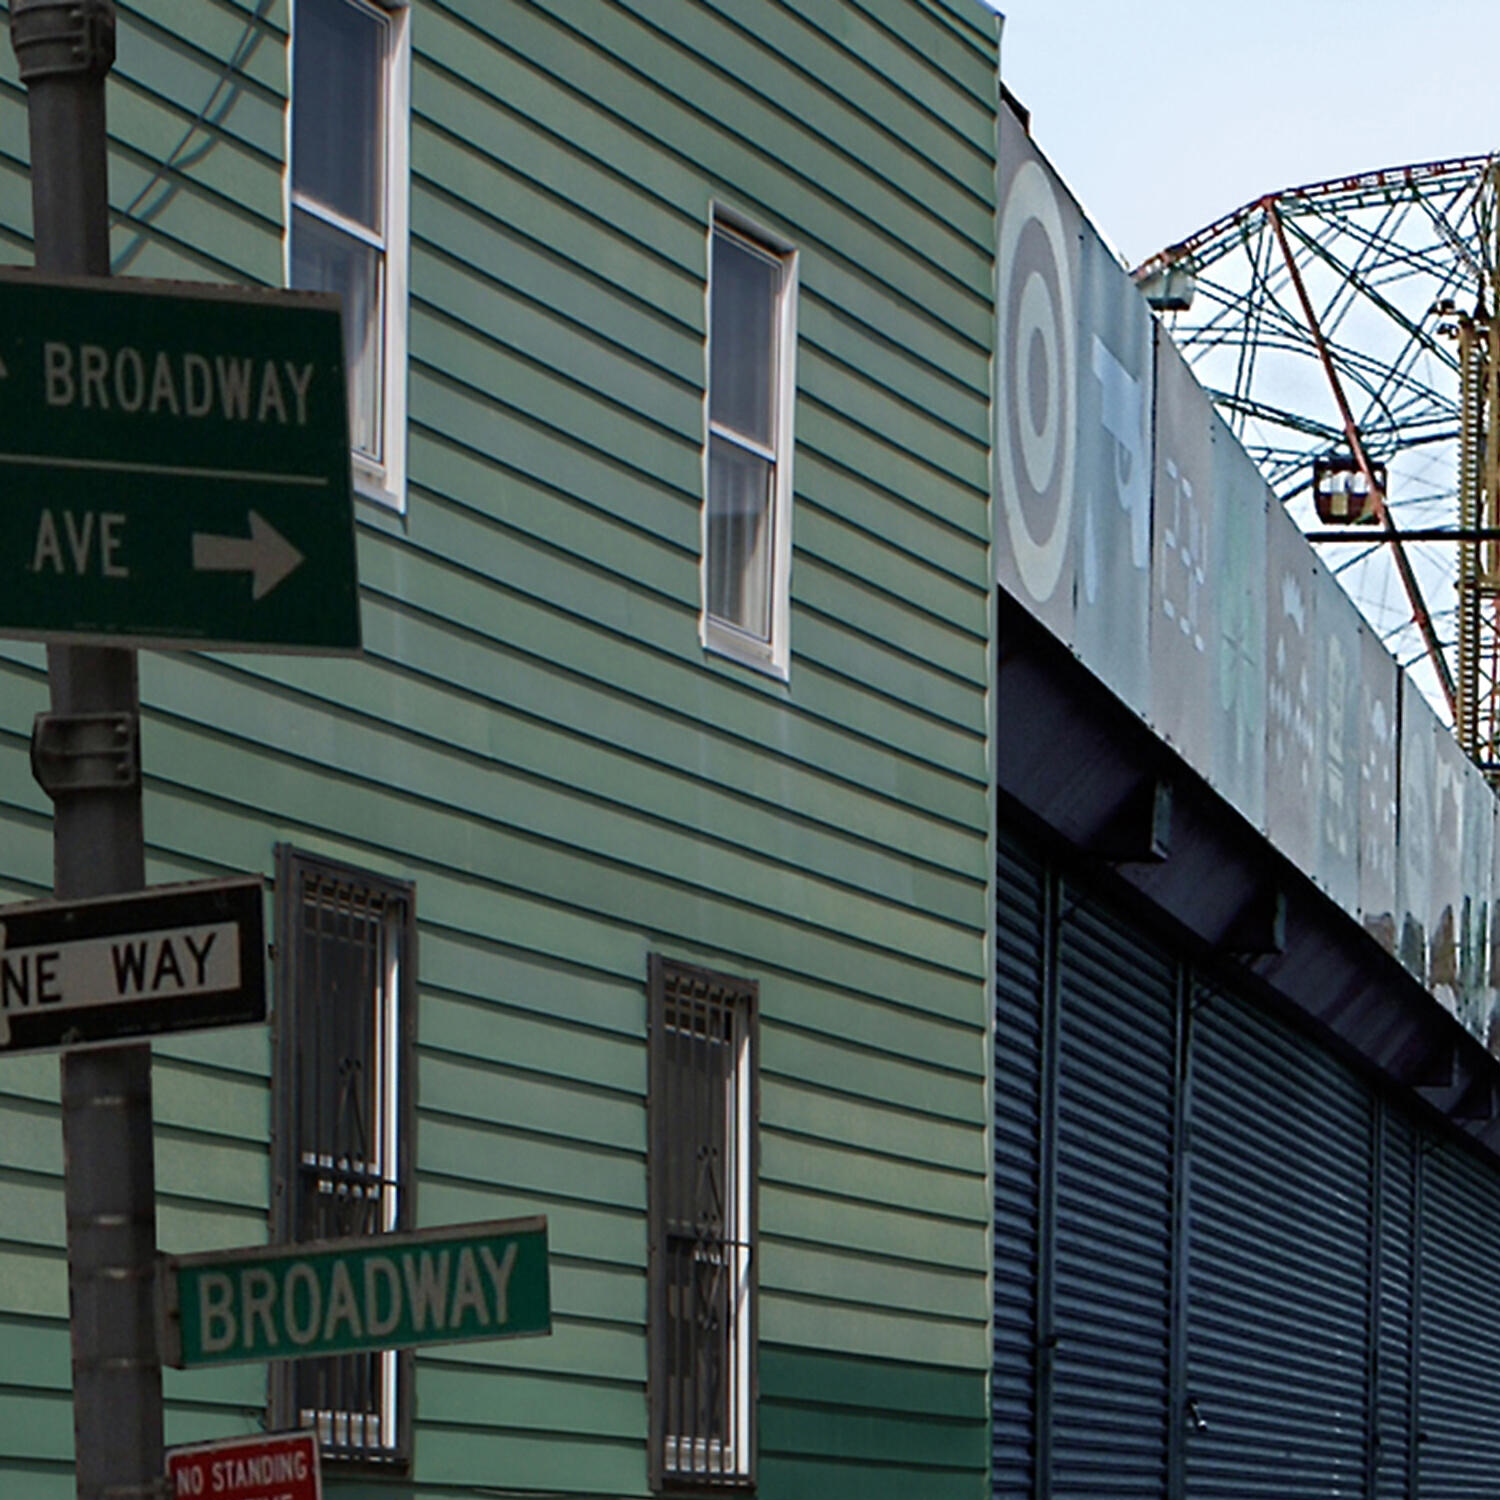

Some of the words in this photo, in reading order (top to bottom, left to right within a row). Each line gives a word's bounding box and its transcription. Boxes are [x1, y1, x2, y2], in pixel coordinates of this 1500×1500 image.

[43, 341, 314, 425] BROADWAY
[31, 508, 129, 578] AVE
[0, 951, 62, 1009] NE
[111, 932, 217, 995] WAY
[198, 1242, 518, 1352] BROADWAY
[176, 1465, 204, 1496] NO
[211, 1450, 308, 1492] STANDING
